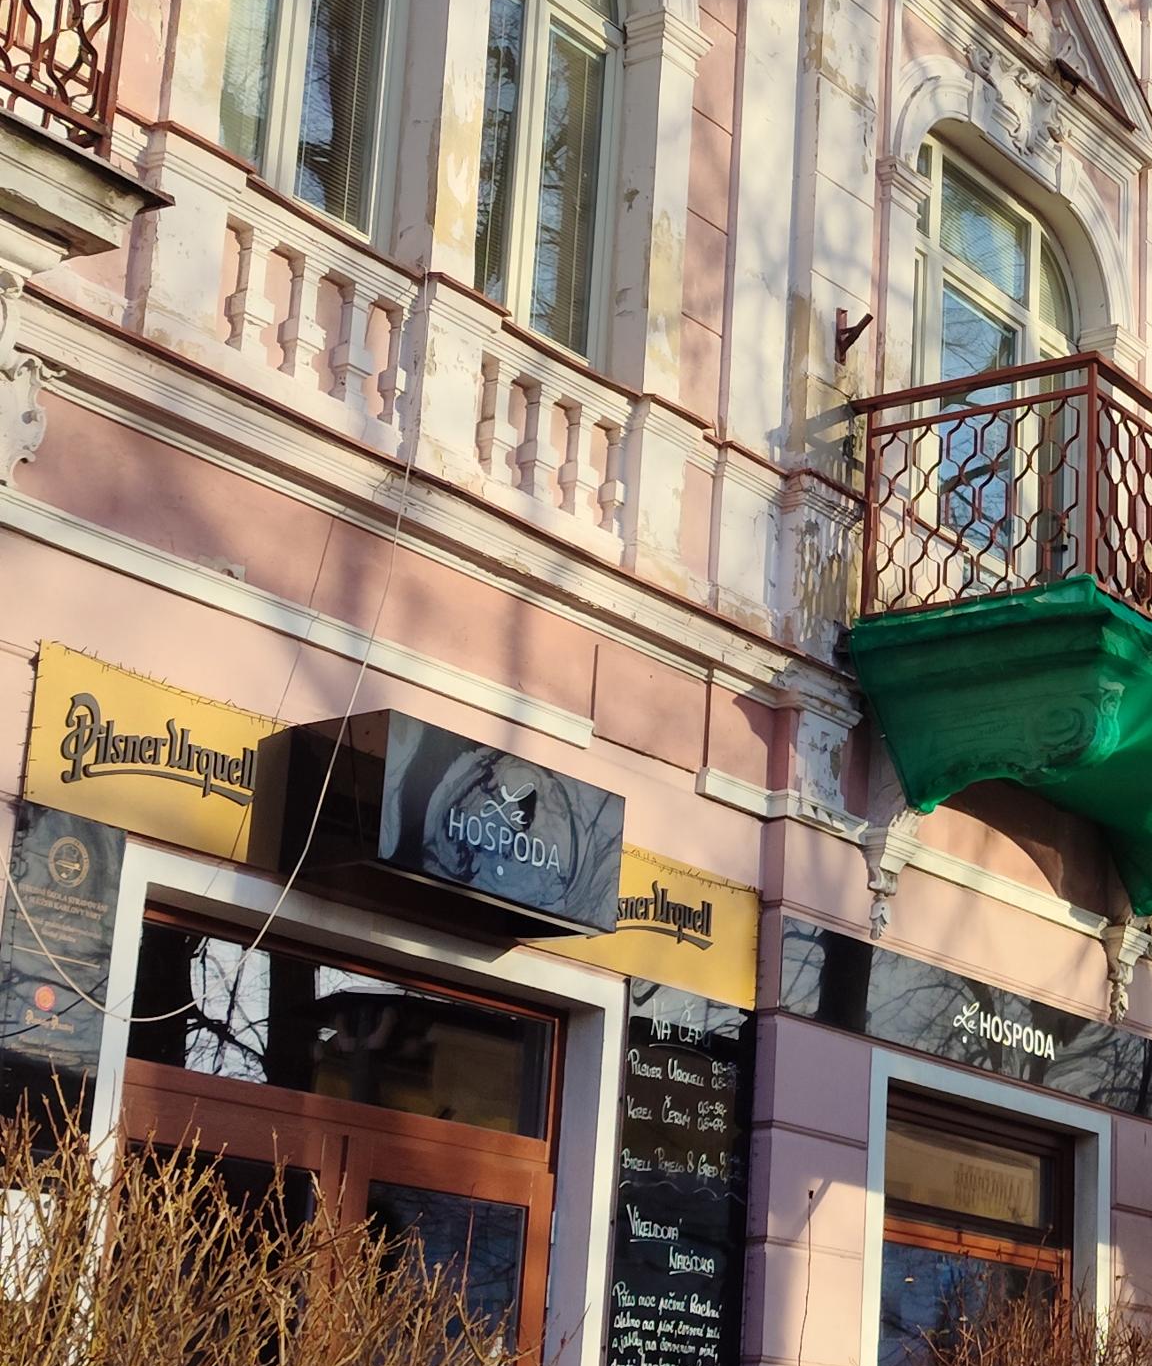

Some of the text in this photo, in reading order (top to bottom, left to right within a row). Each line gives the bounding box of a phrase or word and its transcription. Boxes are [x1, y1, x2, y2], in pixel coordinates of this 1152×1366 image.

[60, 692, 258, 799] Pilsner Urquell
[480, 782, 536, 832] La
[448, 808, 561, 874] HOSPODA
[651, 880, 713, 945] Urquell
[651, 999, 671, 1041] NA
[953, 1001, 1055, 1061] La HOSPODA
